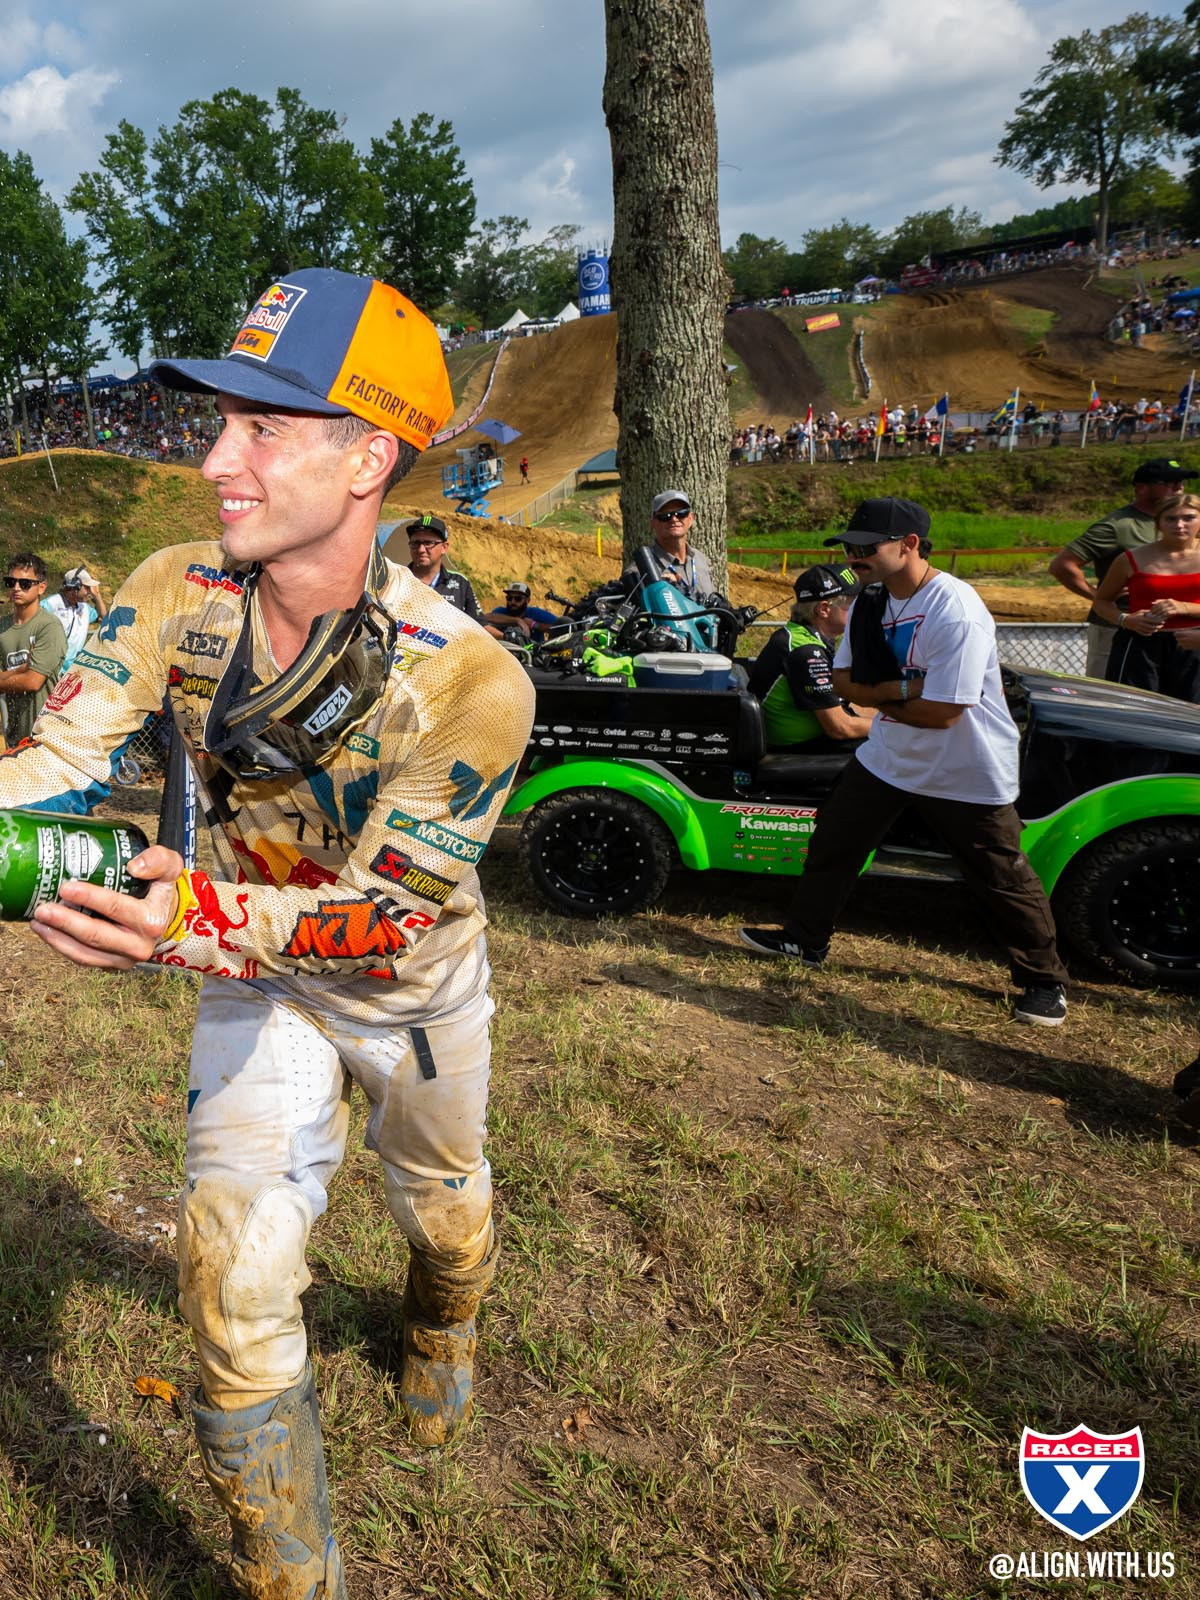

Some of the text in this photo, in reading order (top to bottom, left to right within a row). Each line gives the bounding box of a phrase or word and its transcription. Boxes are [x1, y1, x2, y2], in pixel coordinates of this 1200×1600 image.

[345, 374, 408, 419] FACTORY
[311, 692, 346, 729] 100%
[720, 804, 817, 819] PRO CIRC
[740, 816, 817, 833] Kawasak
[401, 867, 454, 902] AKRAPO
